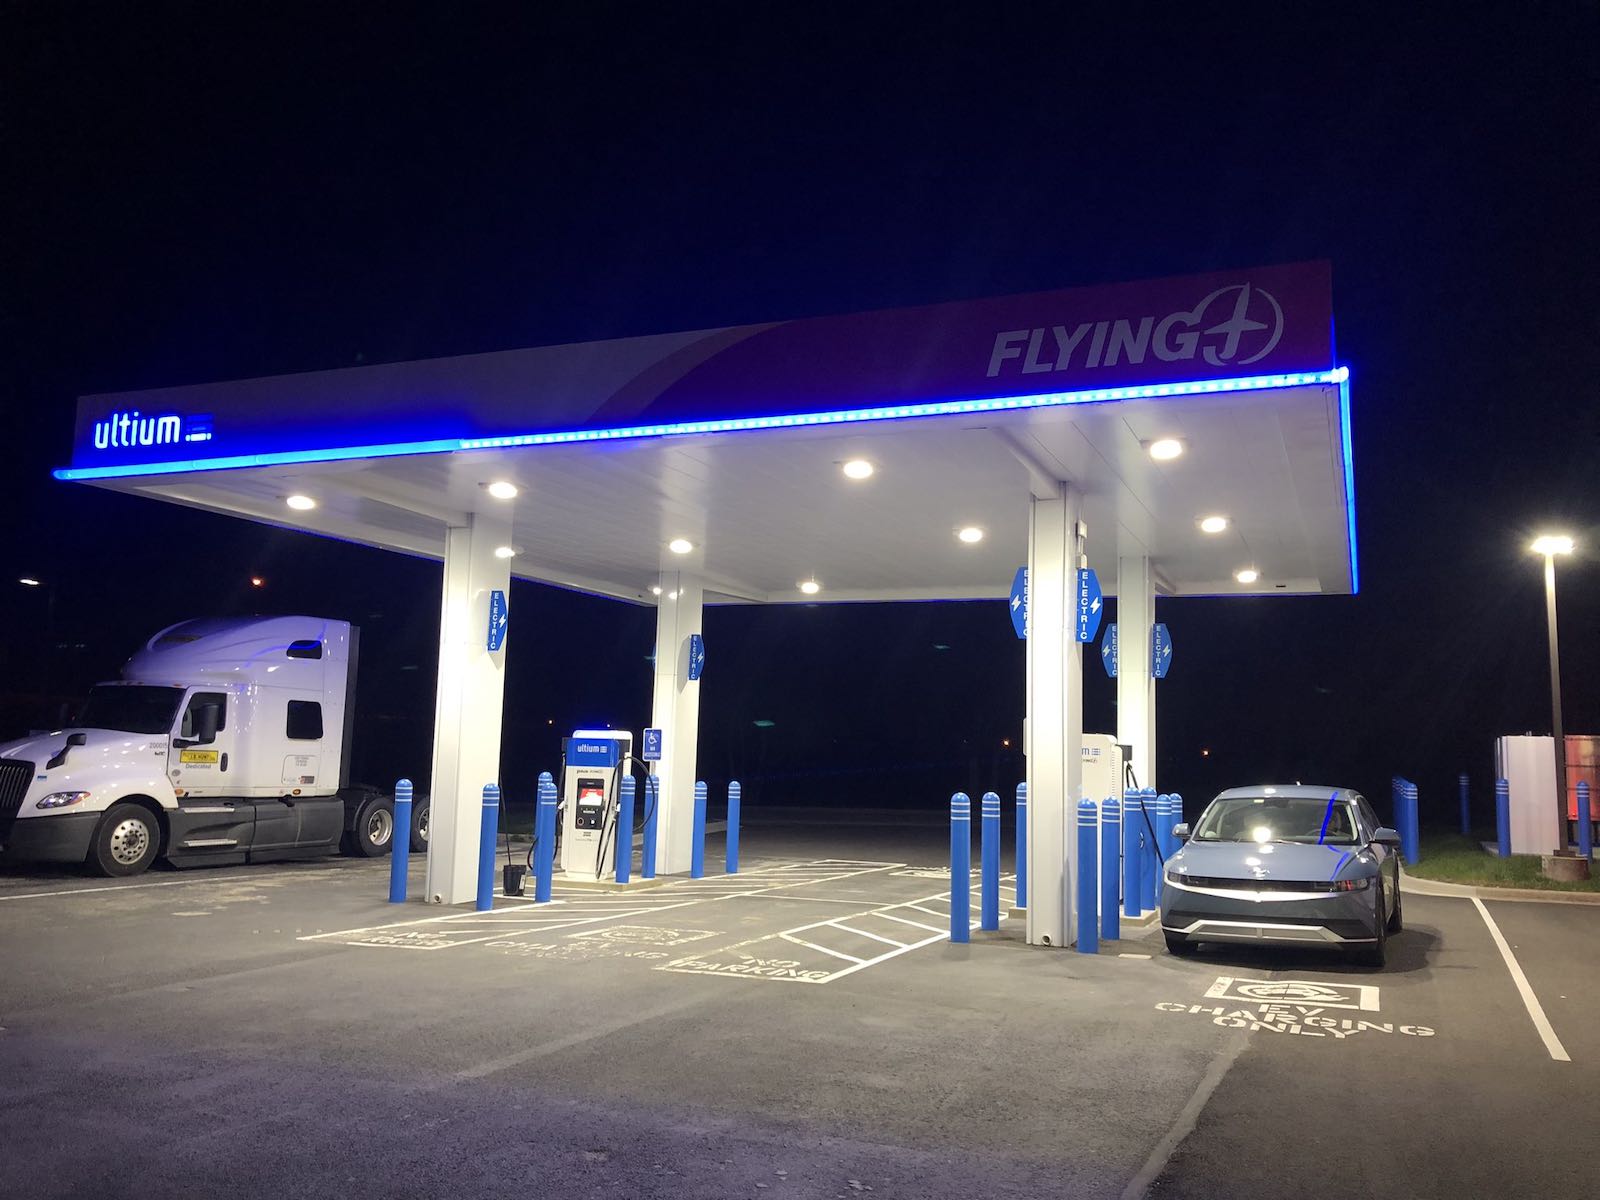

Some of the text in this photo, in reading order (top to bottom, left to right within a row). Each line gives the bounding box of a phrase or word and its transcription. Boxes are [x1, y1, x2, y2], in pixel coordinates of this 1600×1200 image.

[986, 311, 1201, 377] FLYING
[94, 411, 181, 449] ultium
[490, 592, 499, 650] ELECTRIC
[1080, 571, 1089, 640] ELECTRIC
[690, 635, 698, 680] ELECTRIC
[577, 743, 600, 753] ultium
[676, 961, 830, 979] PARKING
[1154, 1002, 1436, 1037] CHARGING
[1213, 1016, 1361, 1039] ONLY
[1258, 1003, 1325, 1016] EV
